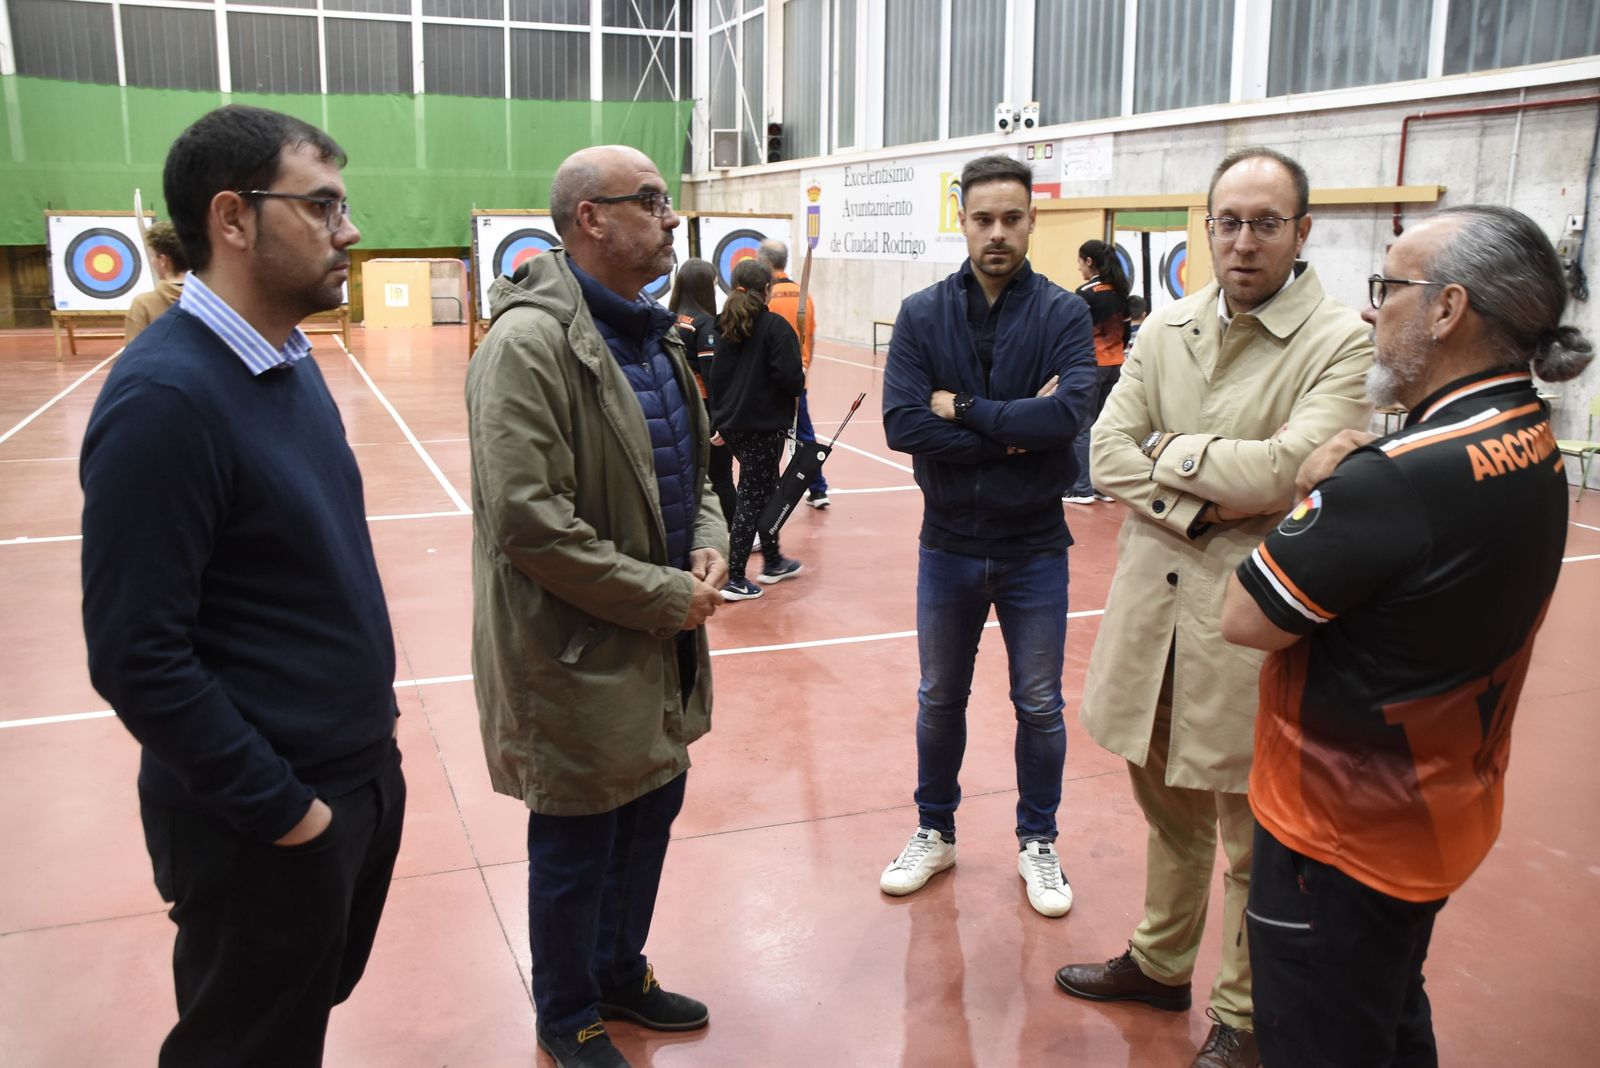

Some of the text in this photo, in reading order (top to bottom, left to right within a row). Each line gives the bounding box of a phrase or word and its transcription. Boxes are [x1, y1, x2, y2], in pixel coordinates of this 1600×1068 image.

[842, 195, 913, 222] Ayuntamiento
[830, 231, 926, 260] de Ciudad Rodrigo
